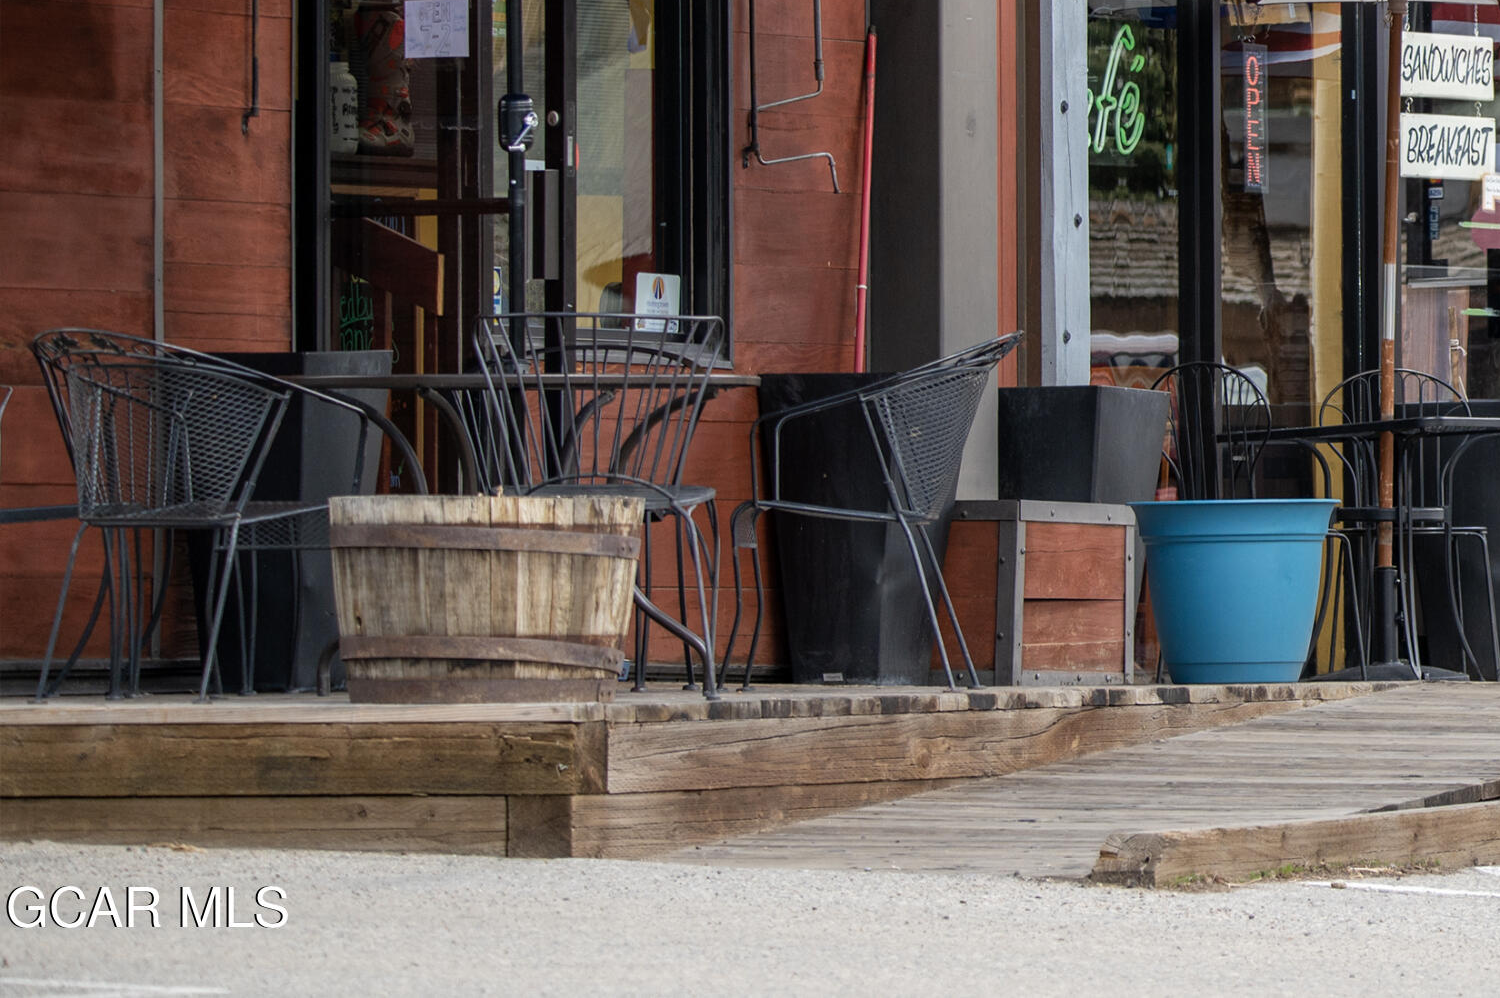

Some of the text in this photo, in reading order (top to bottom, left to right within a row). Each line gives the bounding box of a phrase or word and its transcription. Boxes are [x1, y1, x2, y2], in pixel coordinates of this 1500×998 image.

[1087, 24, 1145, 154] fé
[1402, 43, 1492, 86] SANDWICHES
[1246, 55, 1260, 183] OPEN
[1407, 124, 1493, 166] BREAKFAST
